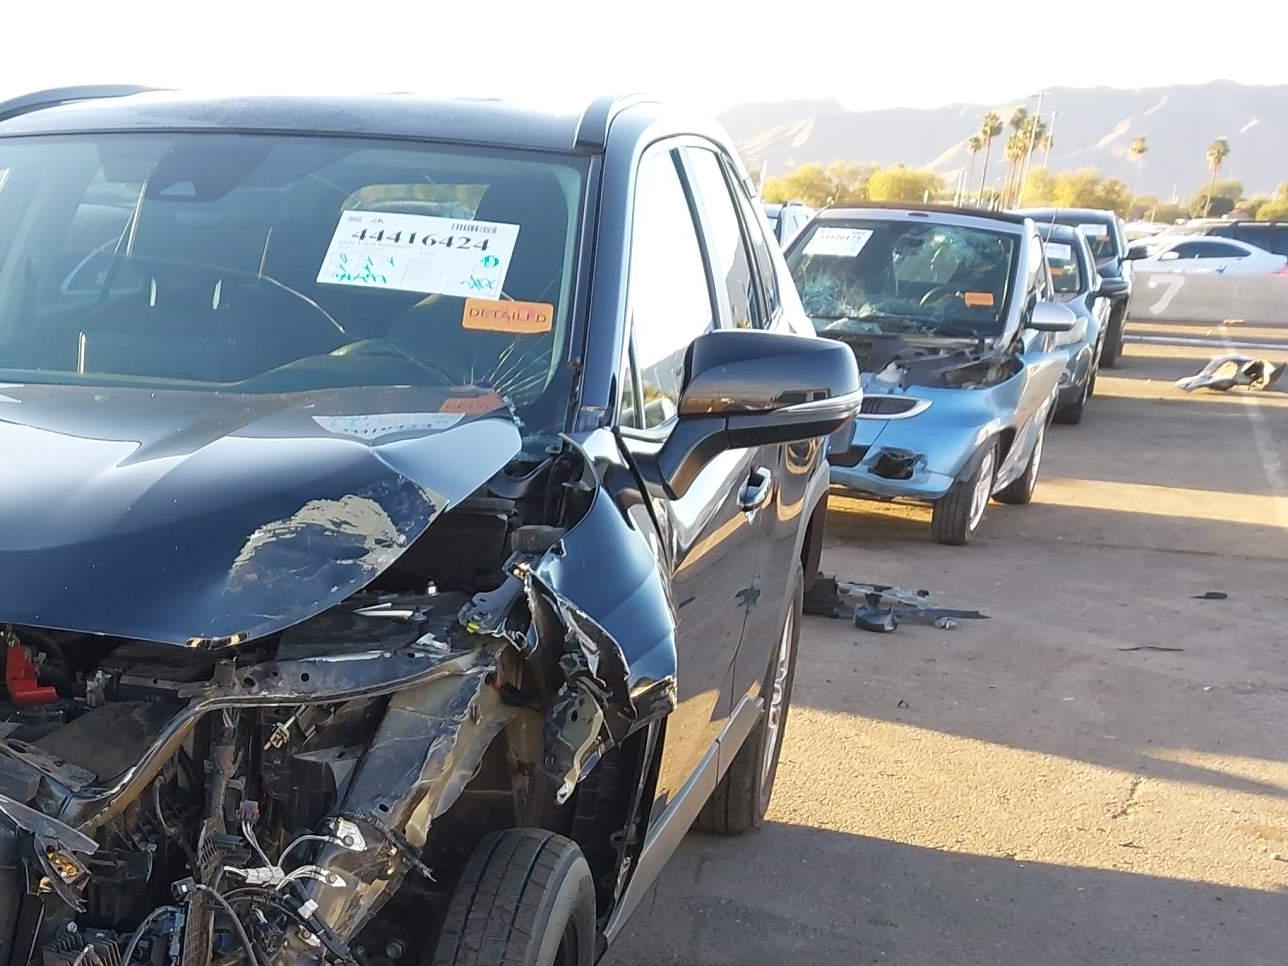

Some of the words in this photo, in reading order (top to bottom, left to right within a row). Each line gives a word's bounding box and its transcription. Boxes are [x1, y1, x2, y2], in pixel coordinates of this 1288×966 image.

[351, 228, 490, 252] 44416424
[1147, 274, 1186, 314] 7
[468, 307, 548, 324] DETAILED
